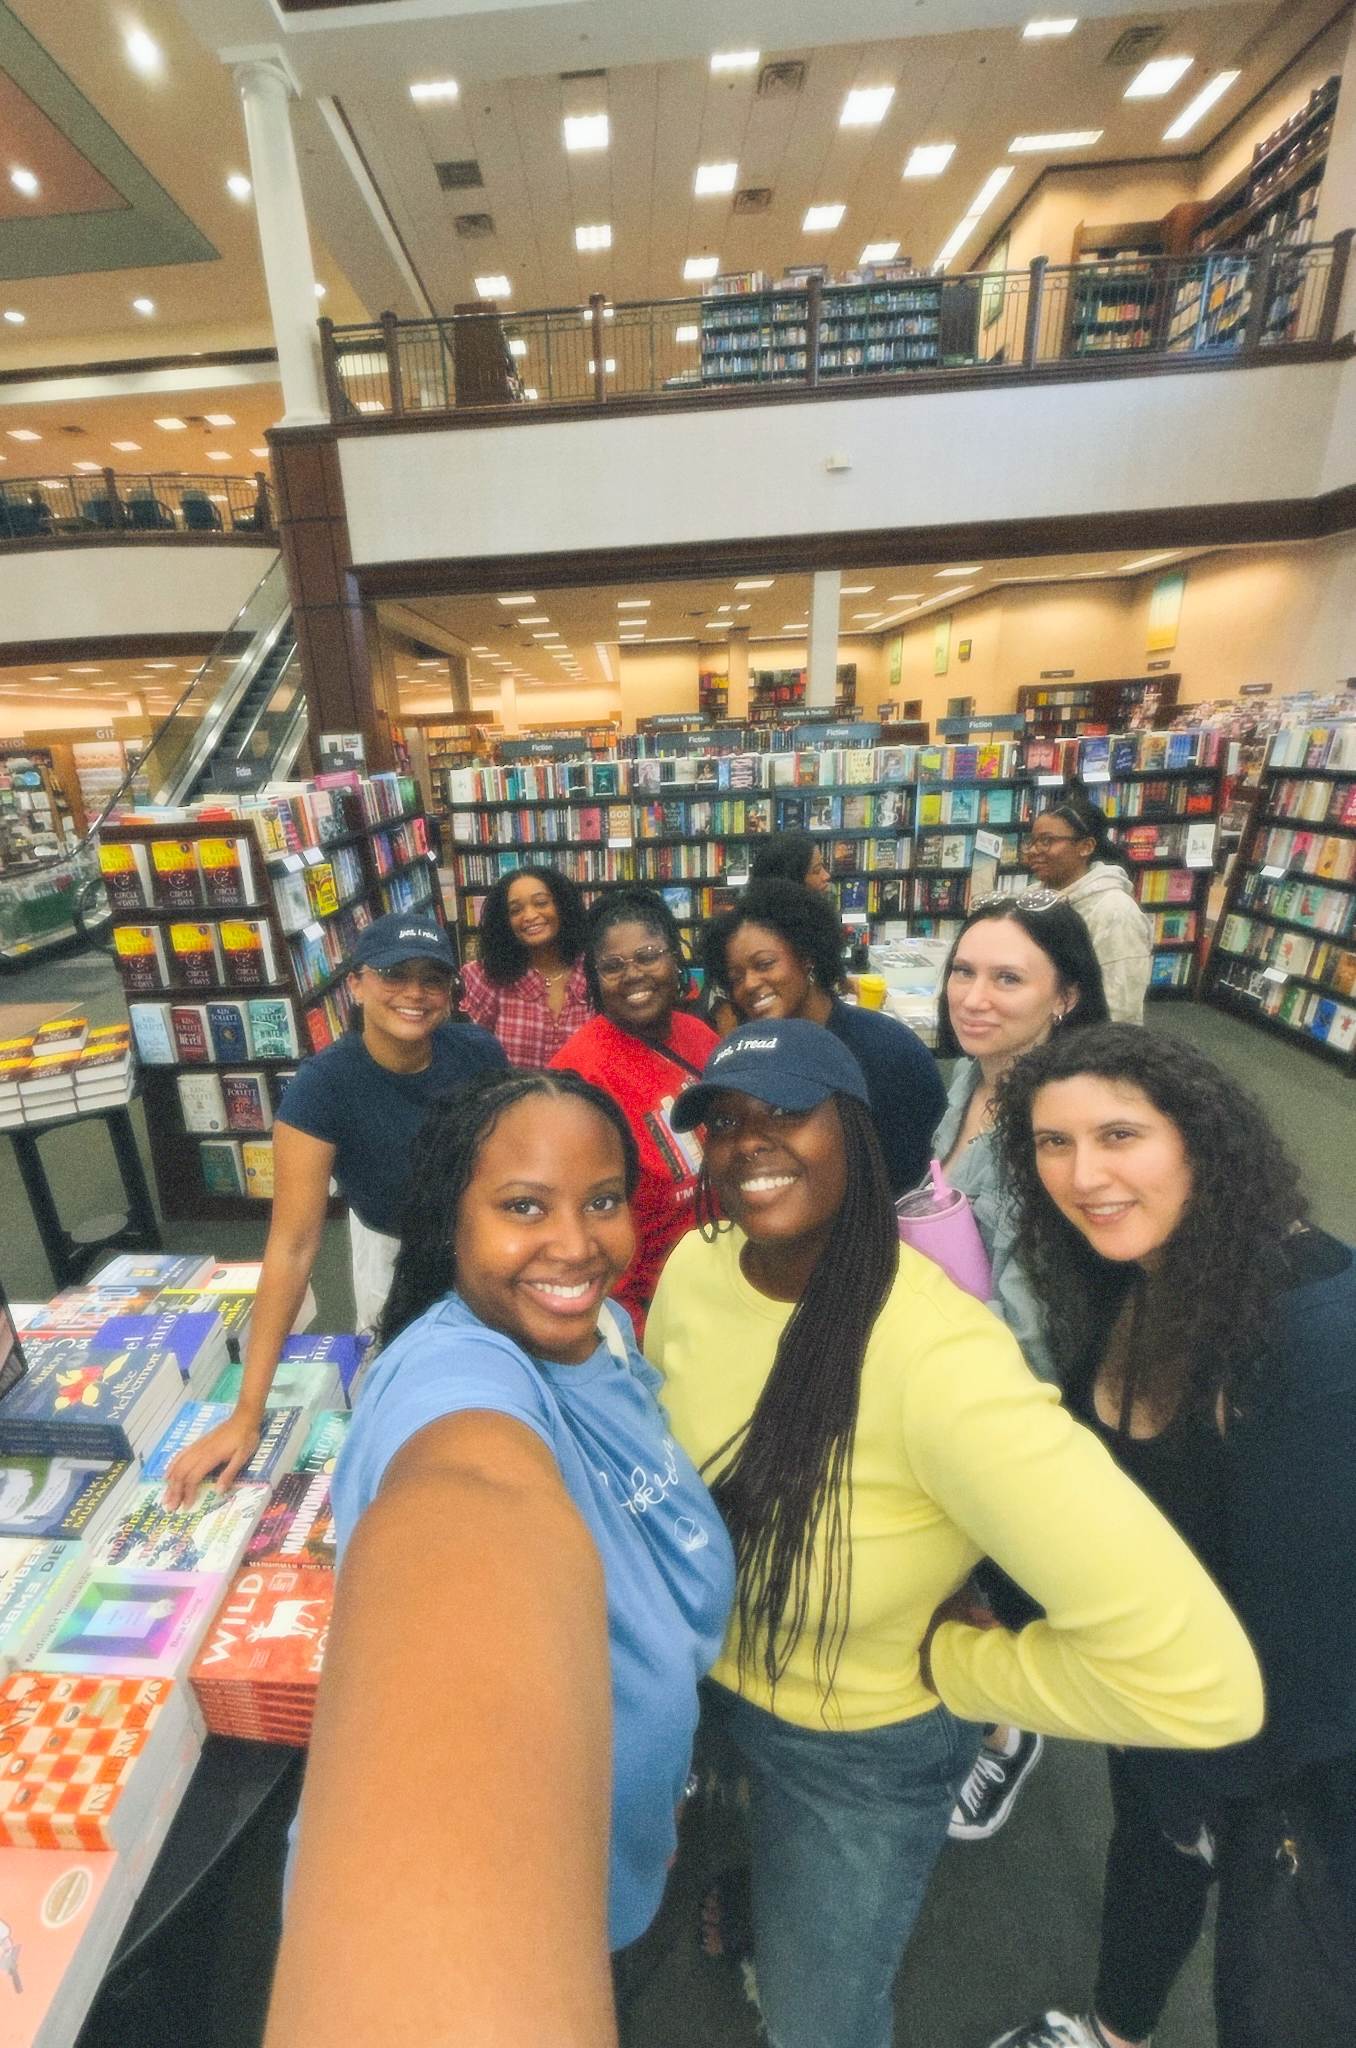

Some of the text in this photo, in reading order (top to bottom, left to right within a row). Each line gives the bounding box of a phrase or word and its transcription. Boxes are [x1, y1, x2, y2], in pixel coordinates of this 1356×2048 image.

[826, 728, 849, 736] Fiction
[968, 720, 992, 728] Fiction
[688, 736, 710, 744] Fiction
[236, 767, 252, 777] Fiction
[610, 810, 629, 818] GOD
[169, 890, 193, 898] CIRCLE
[176, 1024, 202, 1032] FOLLETT
[211, 1014, 238, 1022] FOLLETT
[254, 1014, 284, 1022] FOLLETT
[179, 1034, 202, 1046] NEVER
[743, 1038, 778, 1050] read
[227, 1088, 257, 1097] FOLLETT
[124, 1336, 144, 1350] el
[146, 1314, 178, 1350] anto
[107, 1352, 162, 1419] McDermott
[110, 1369, 138, 1398] Alice
[161, 1420, 190, 1452] THE GREAT
[248, 1436, 278, 1471] RACHEL
[268, 1410, 290, 1436] HENG
[305, 1416, 342, 1472] LINCOLN
[61, 1476, 104, 1527] HARUKI
[72, 1460, 128, 1528] MURAKAMI
[140, 1510, 160, 1532] AND
[280, 1474, 332, 1554] MADWOMAN
[138, 1511, 174, 1560] TOMORR
[39, 1544, 66, 1572] DIE
[26, 1571, 93, 1664] Midnight Timetable
[170, 1597, 204, 1648] Bora Chung
[202, 1574, 263, 1665] WILD
[0, 1679, 50, 1758] ONEY
[87, 1680, 164, 1812] INTERMEZZO
